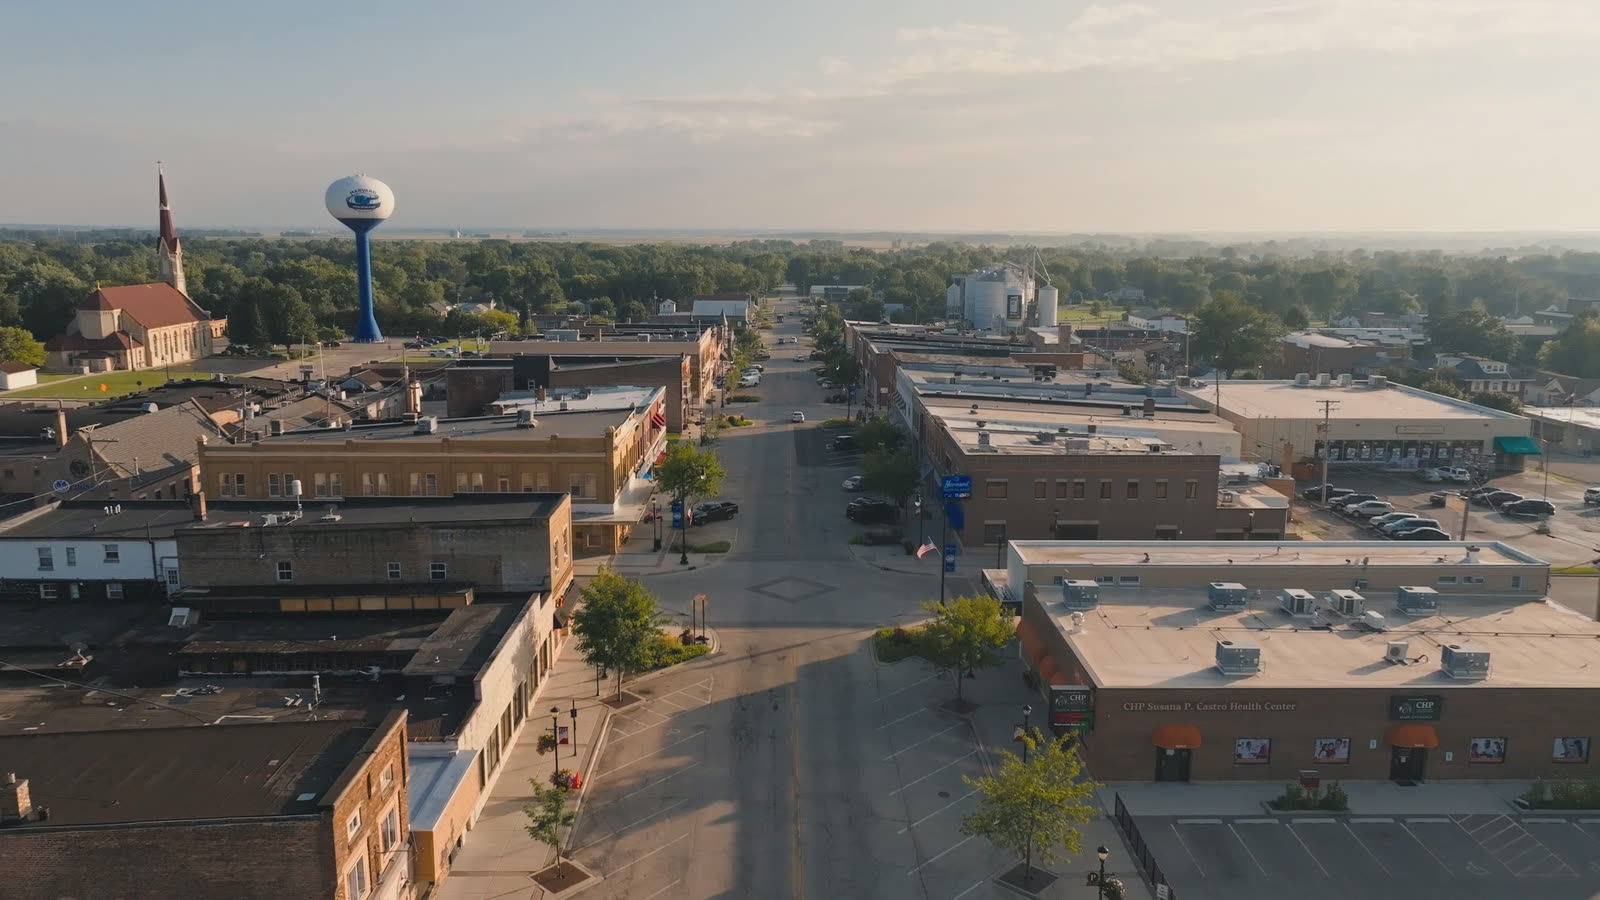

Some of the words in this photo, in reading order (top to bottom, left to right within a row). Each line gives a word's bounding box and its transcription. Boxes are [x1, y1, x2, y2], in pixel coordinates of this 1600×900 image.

[350, 188, 376, 196] HARVARD
[1123, 702, 1145, 711] CHP
[1147, 702, 1182, 711] Susana
[1184, 702, 1193, 711] P.
[1196, 702, 1228, 711] Castro
[1229, 702, 1262, 711] Health
[1264, 702, 1296, 711] Center
